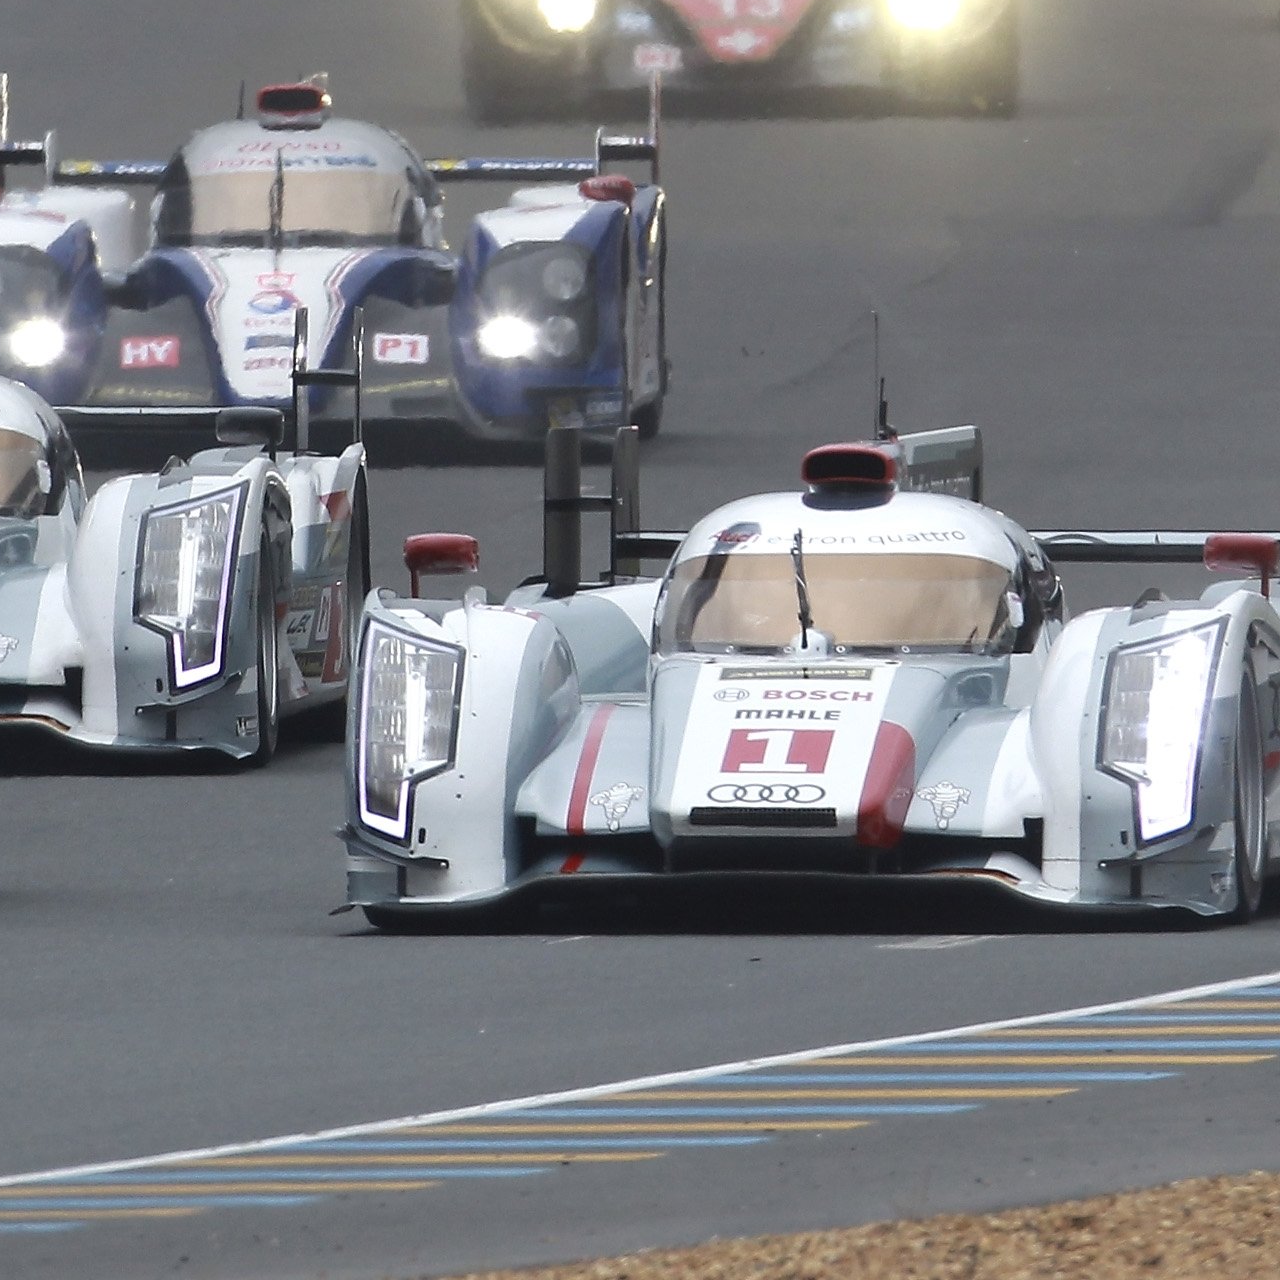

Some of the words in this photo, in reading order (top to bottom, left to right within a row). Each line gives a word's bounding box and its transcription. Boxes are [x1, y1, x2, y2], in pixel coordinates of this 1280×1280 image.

[122, 341, 173, 365] HY
[377, 338, 420, 360] P1
[767, 533, 857, 545] e-ron
[867, 528, 967, 546] quattro
[762, 689, 875, 702] BOSCH
[734, 708, 842, 721] MAHLE
[737, 729, 809, 772] 1
